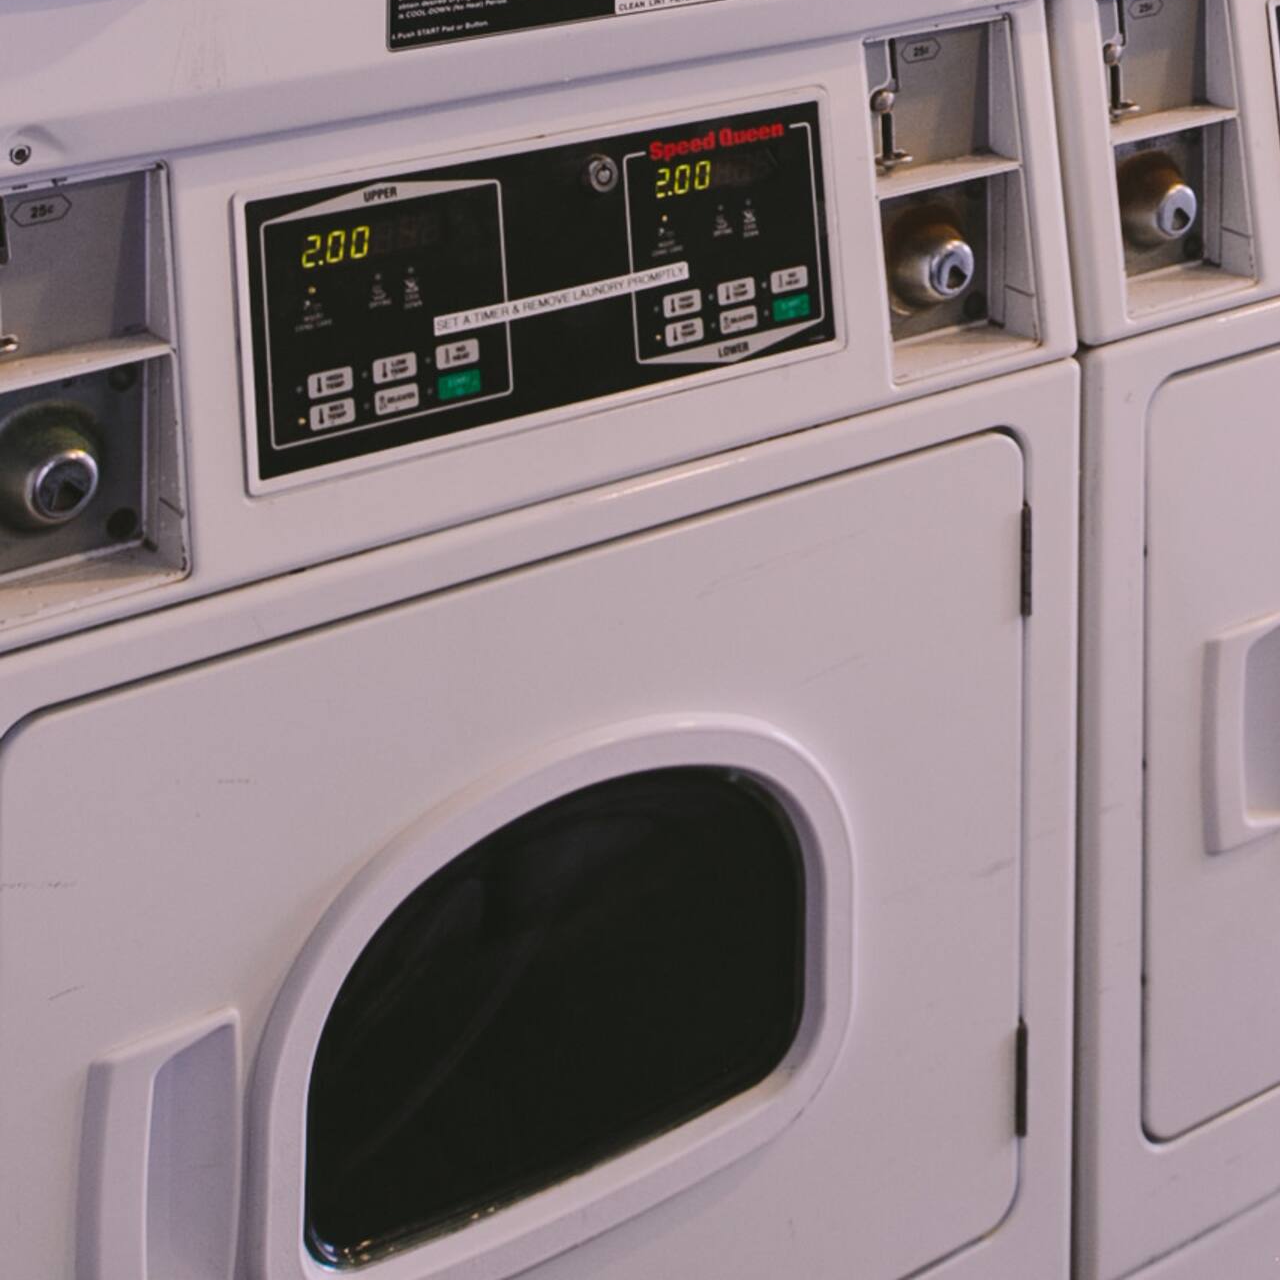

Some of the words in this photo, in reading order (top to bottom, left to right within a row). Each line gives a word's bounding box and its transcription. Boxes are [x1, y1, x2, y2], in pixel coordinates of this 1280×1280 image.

[618, 0, 646, 12] CLEAN
[650, 128, 716, 161] Speed
[719, 122, 784, 146] Queen
[363, 186, 398, 203] UPPER
[656, 160, 711, 198] 2.00
[302, 225, 370, 268] 2.00
[436, 317, 460, 332] SET
[462, 314, 472, 325] A
[474, 305, 510, 324] TIMER
[511, 303, 521, 315] &
[523, 291, 574, 313] REMOVE
[573, 280, 626, 301] LAUNDRY
[627, 265, 687, 290] PROMPTLY
[718, 341, 749, 358] LOWER
